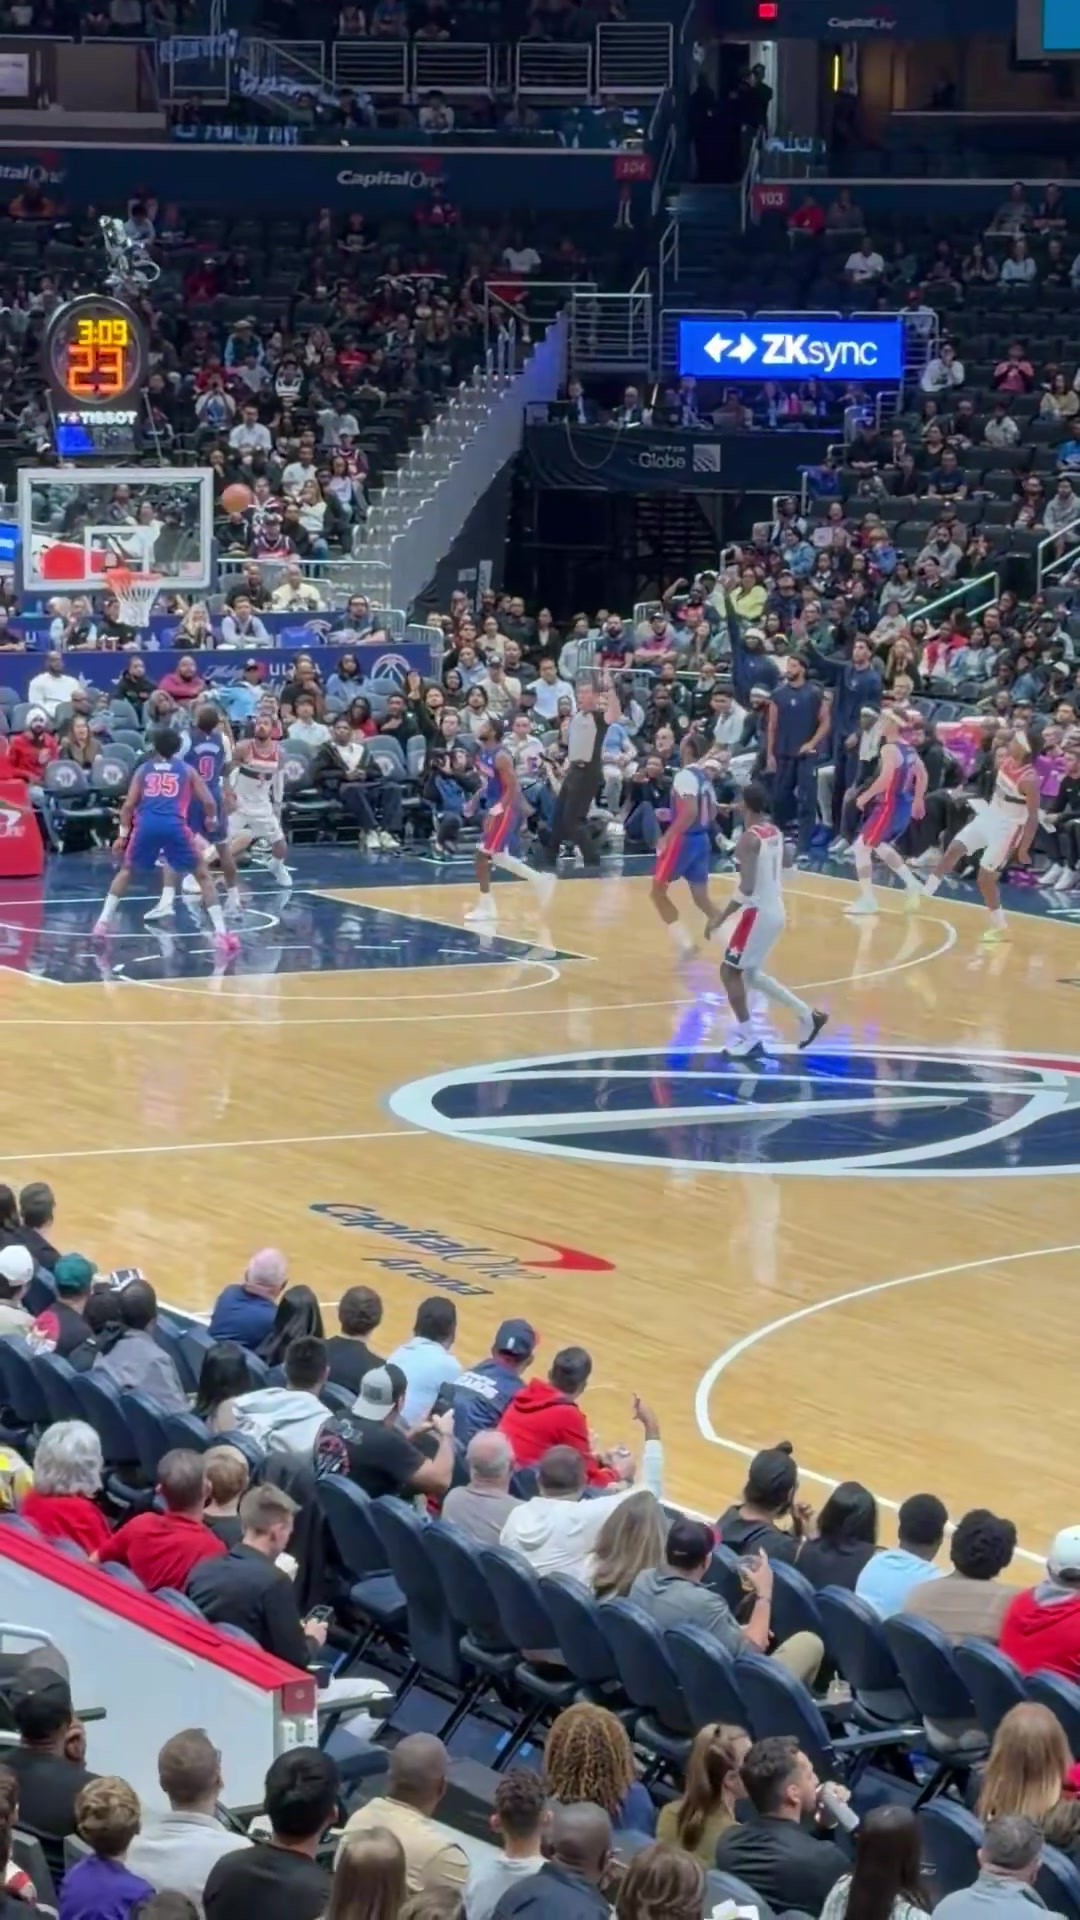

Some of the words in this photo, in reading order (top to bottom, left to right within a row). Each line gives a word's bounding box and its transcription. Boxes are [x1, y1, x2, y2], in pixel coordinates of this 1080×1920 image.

[760, 192, 784, 205] 103
[78, 319, 127, 345] 3:09
[761, 333, 878, 372] ZKsync
[68, 345, 123, 392] 23
[639, 452, 686, 469] Globe
[144, 772, 179, 797] 35
[361, 1257, 494, 1295] Arena
